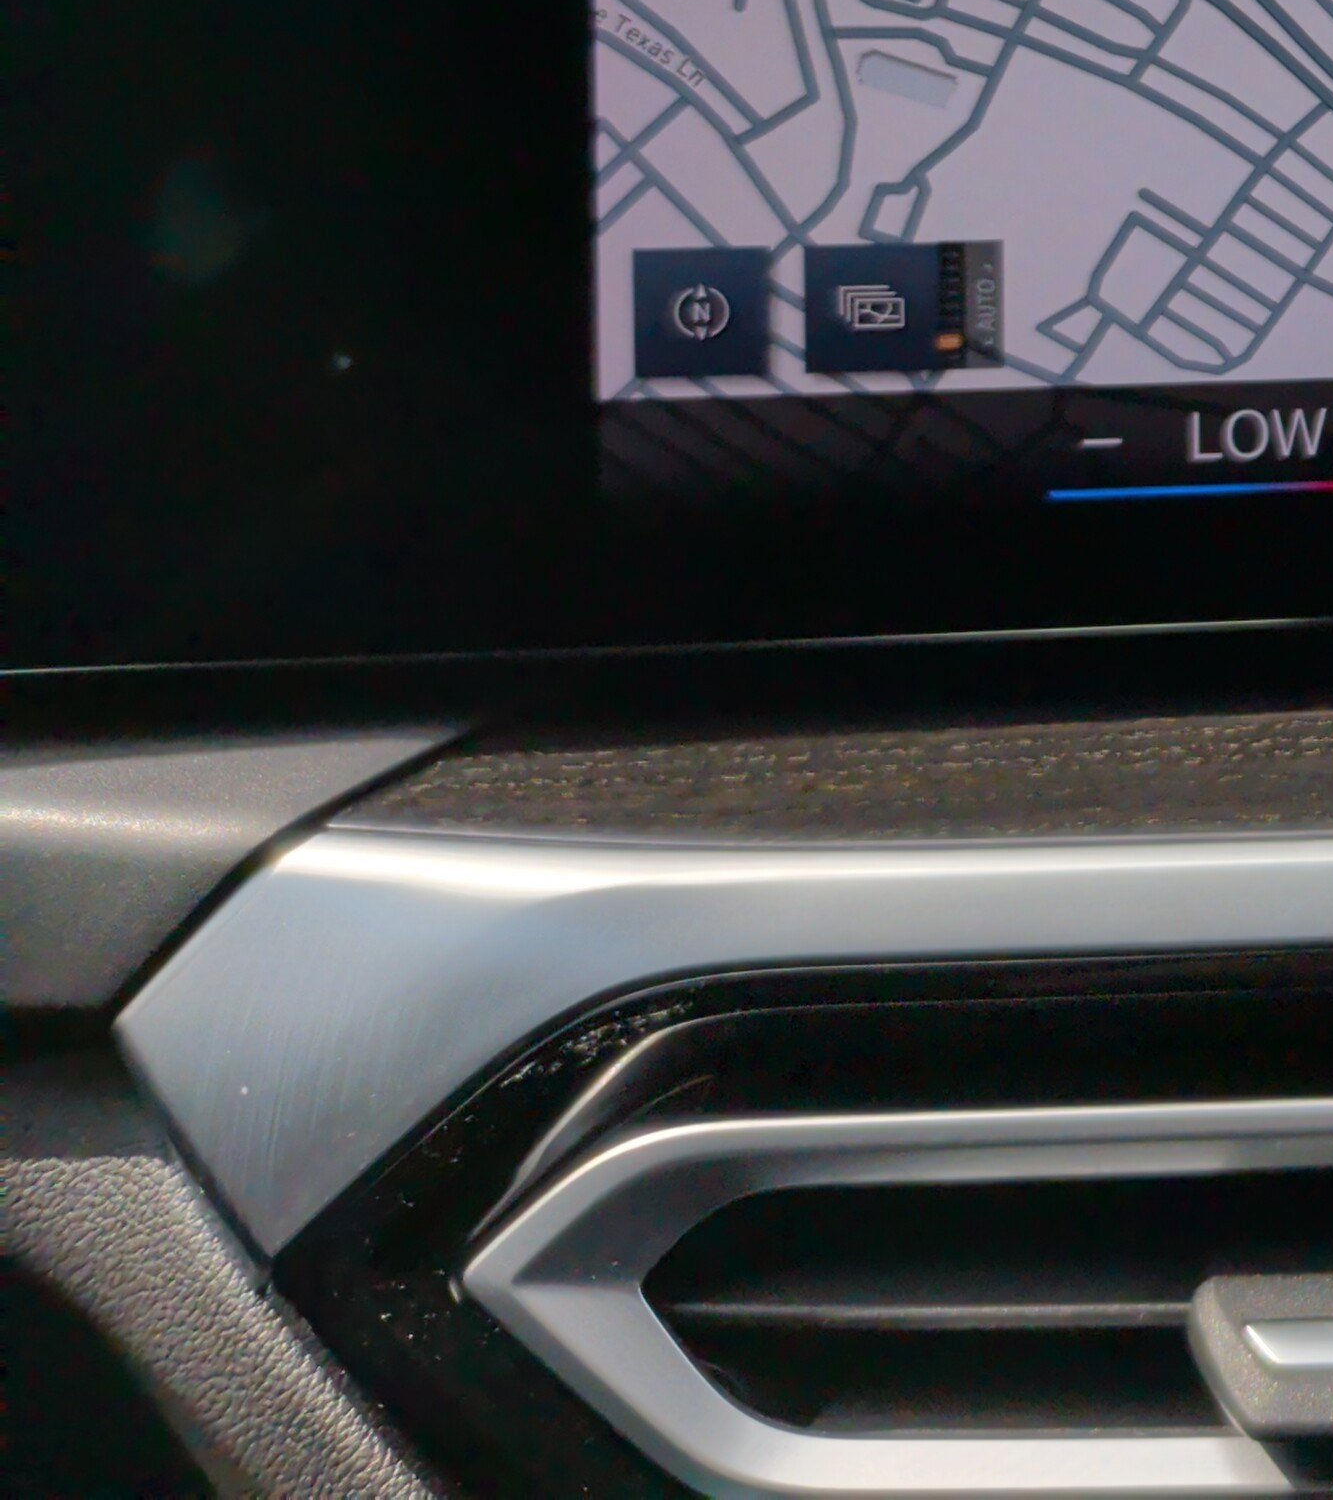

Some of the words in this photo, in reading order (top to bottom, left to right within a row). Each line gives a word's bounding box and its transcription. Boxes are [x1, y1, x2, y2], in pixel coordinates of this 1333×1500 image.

[615, 13, 674, 64] Texas
[677, 58, 704, 87] Ln
[692, 302, 710, 322] N
[1186, 407, 1328, 463] LOW
